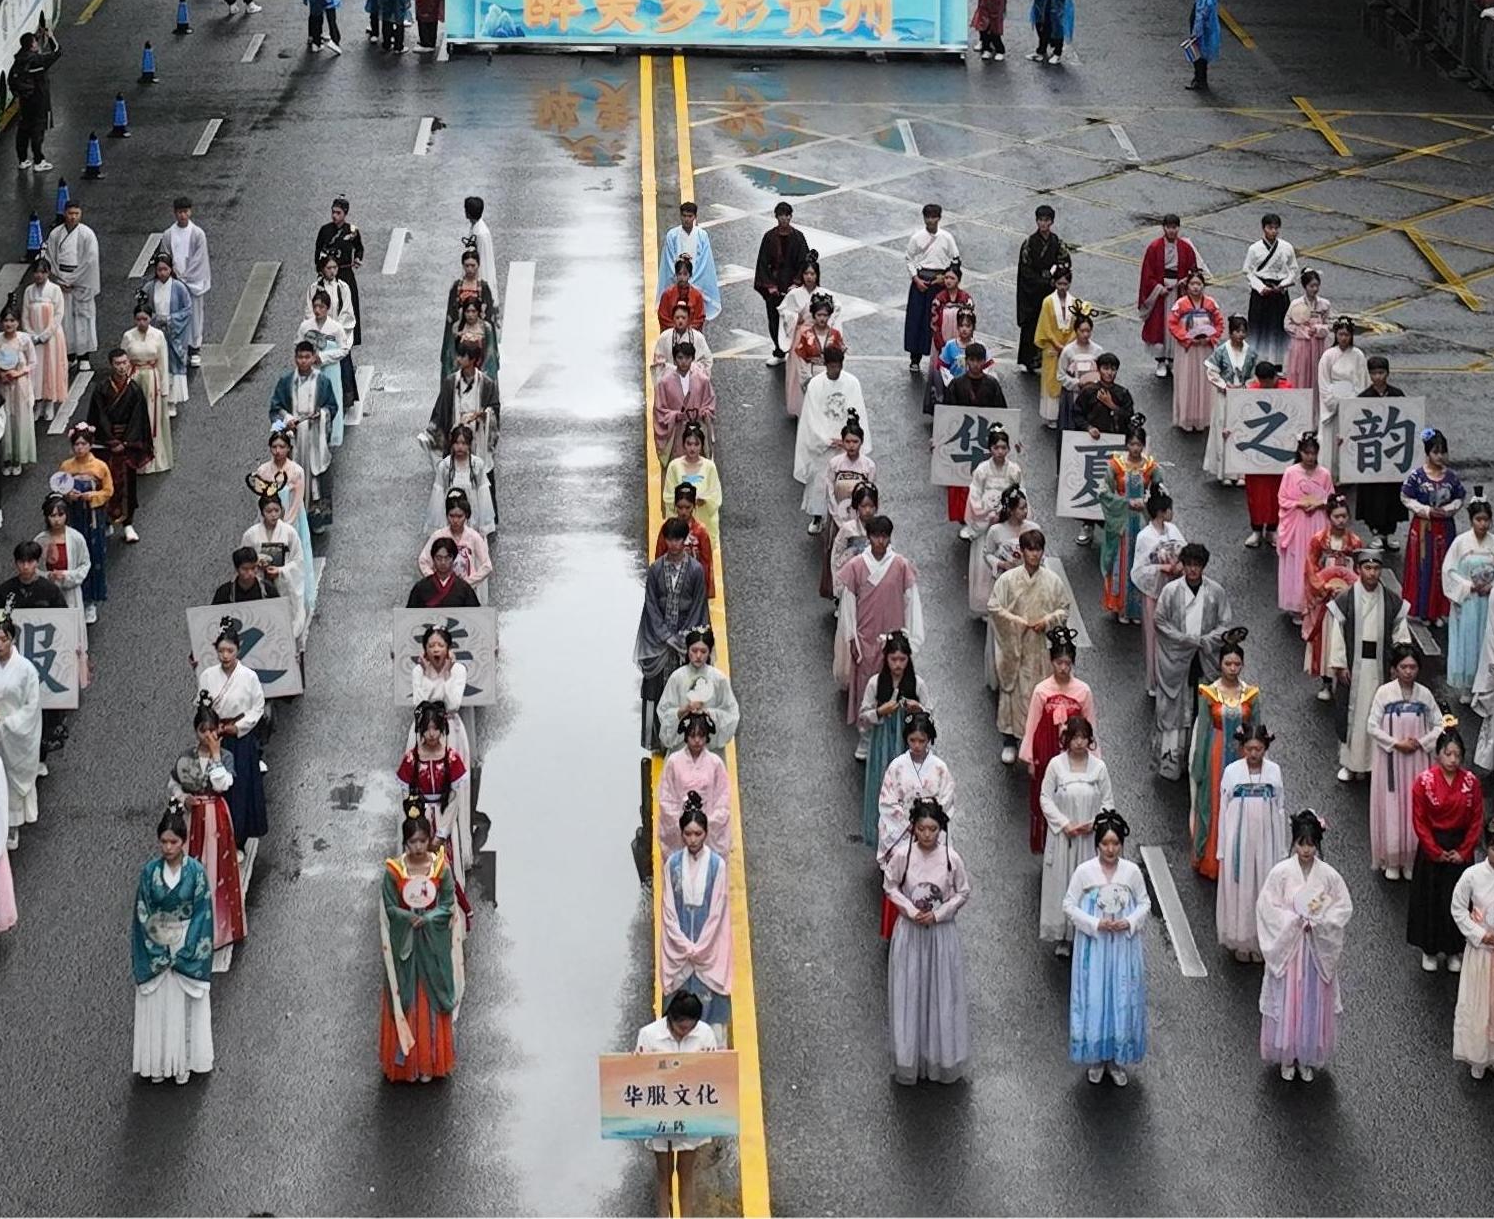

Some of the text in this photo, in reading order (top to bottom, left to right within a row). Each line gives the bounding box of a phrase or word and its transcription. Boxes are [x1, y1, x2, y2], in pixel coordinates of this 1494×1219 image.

[944, 414, 992, 476] 华
[1235, 401, 1297, 462] 之
[1349, 406, 1416, 474] 韵
[624, 1083, 719, 1108] 华服文化
